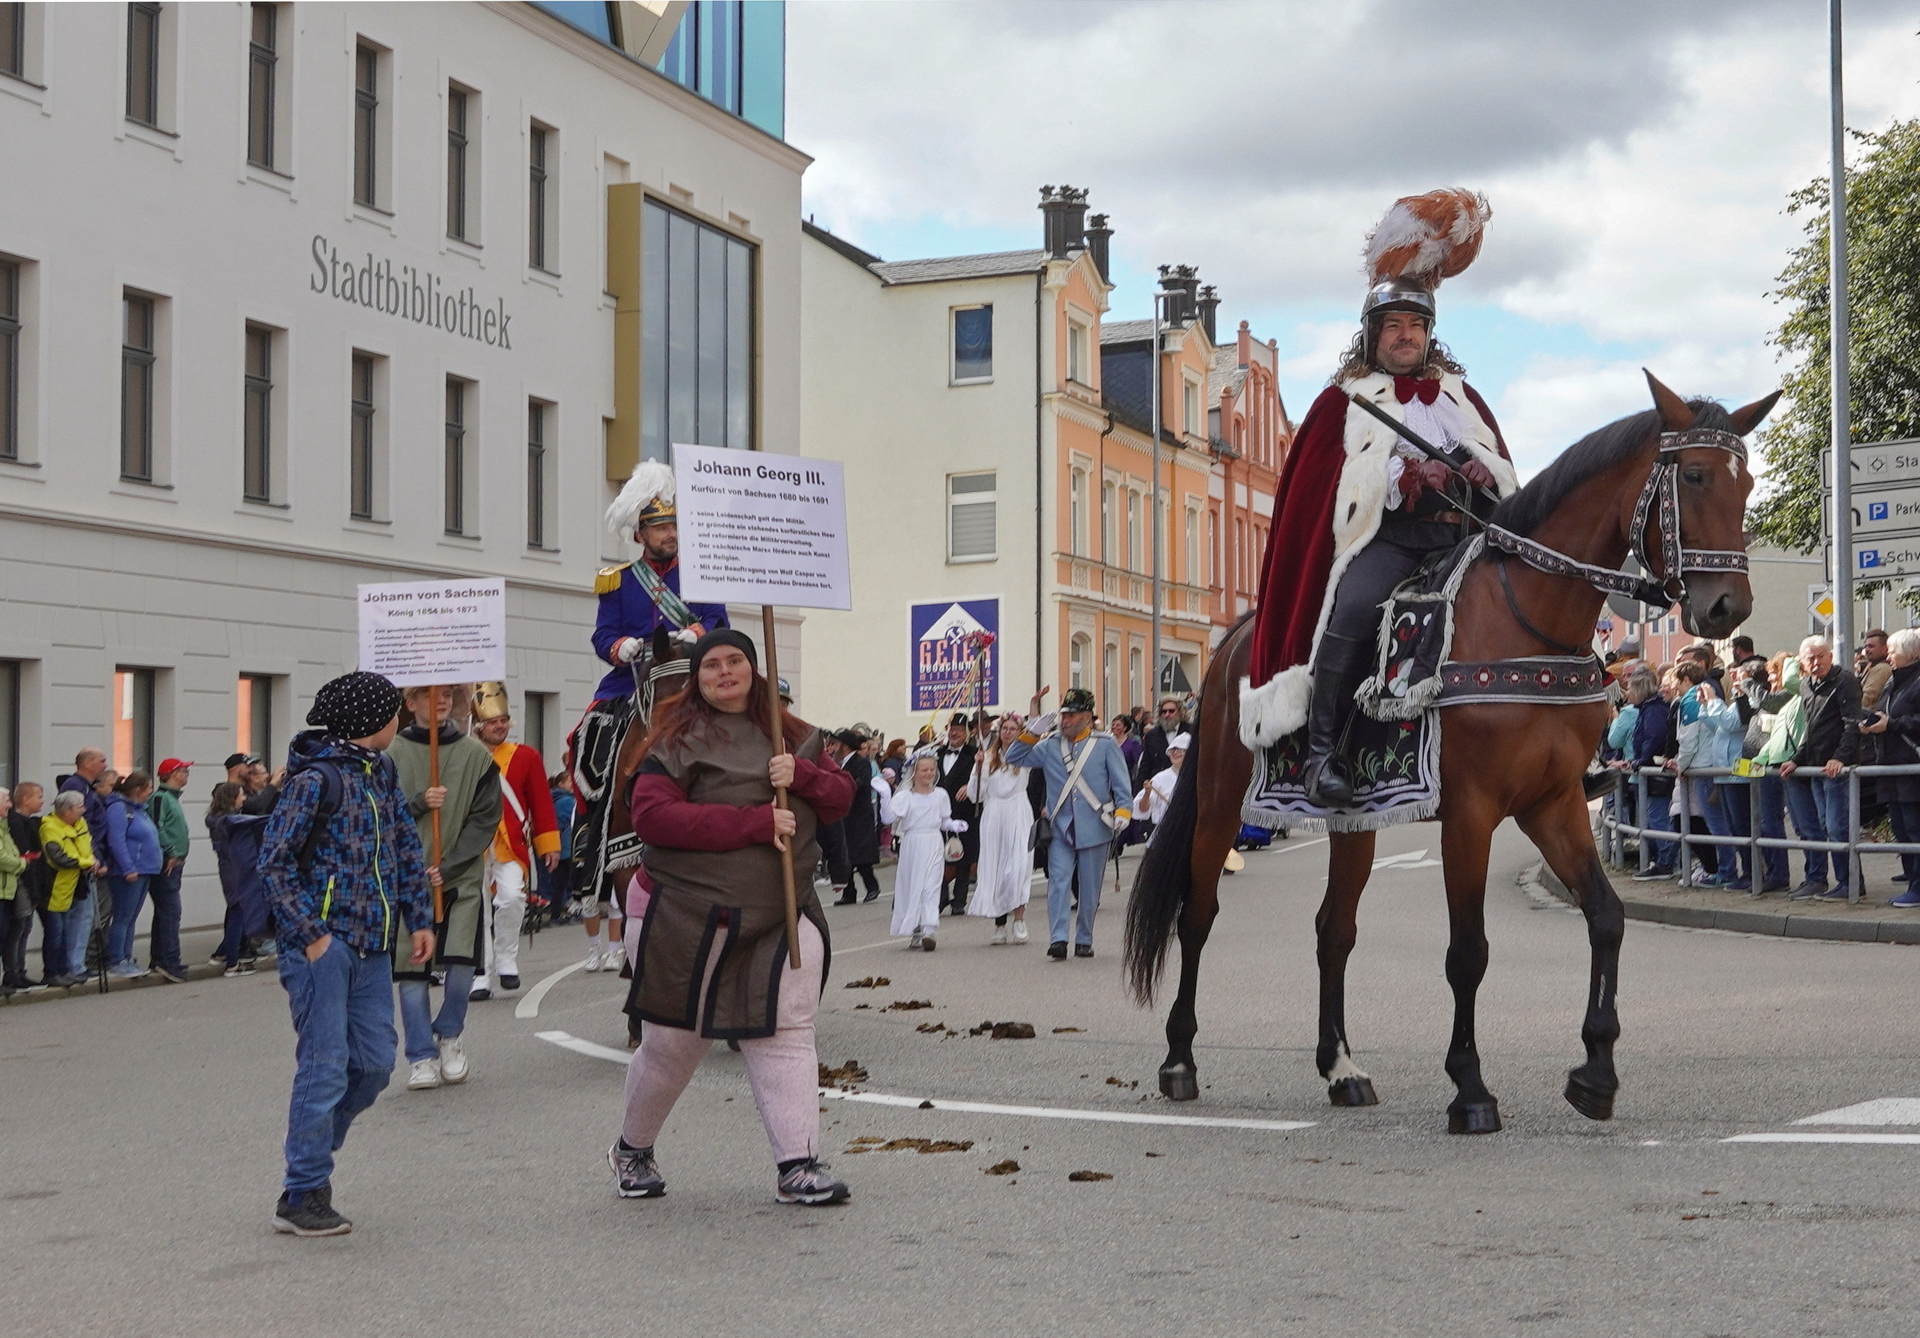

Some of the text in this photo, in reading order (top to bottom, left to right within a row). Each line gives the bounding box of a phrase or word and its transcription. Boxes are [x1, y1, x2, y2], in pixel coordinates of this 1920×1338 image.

[311, 235, 512, 350] Stadtbibliothek
[694, 459, 825, 486] Johann Georg III.
[691, 484, 829, 505] Kurfürst von Sachsen 1680 bis 1691
[716, 511, 757, 520] Leidenschaft
[712, 533, 748, 542] reformierte
[813, 550, 830, 558] Kunst
[724, 565, 767, 575] Beauftragung
[794, 569, 815, 578] Caspar
[726, 575, 746, 583] führte
[768, 578, 791, 586] Ausbau
[363, 588, 500, 603] Johann von Sachsen
[387, 608, 414, 617] König
[440, 606, 454, 614] bis
[457, 605, 478, 613] 1873
[920, 659, 991, 674] bedachunn
